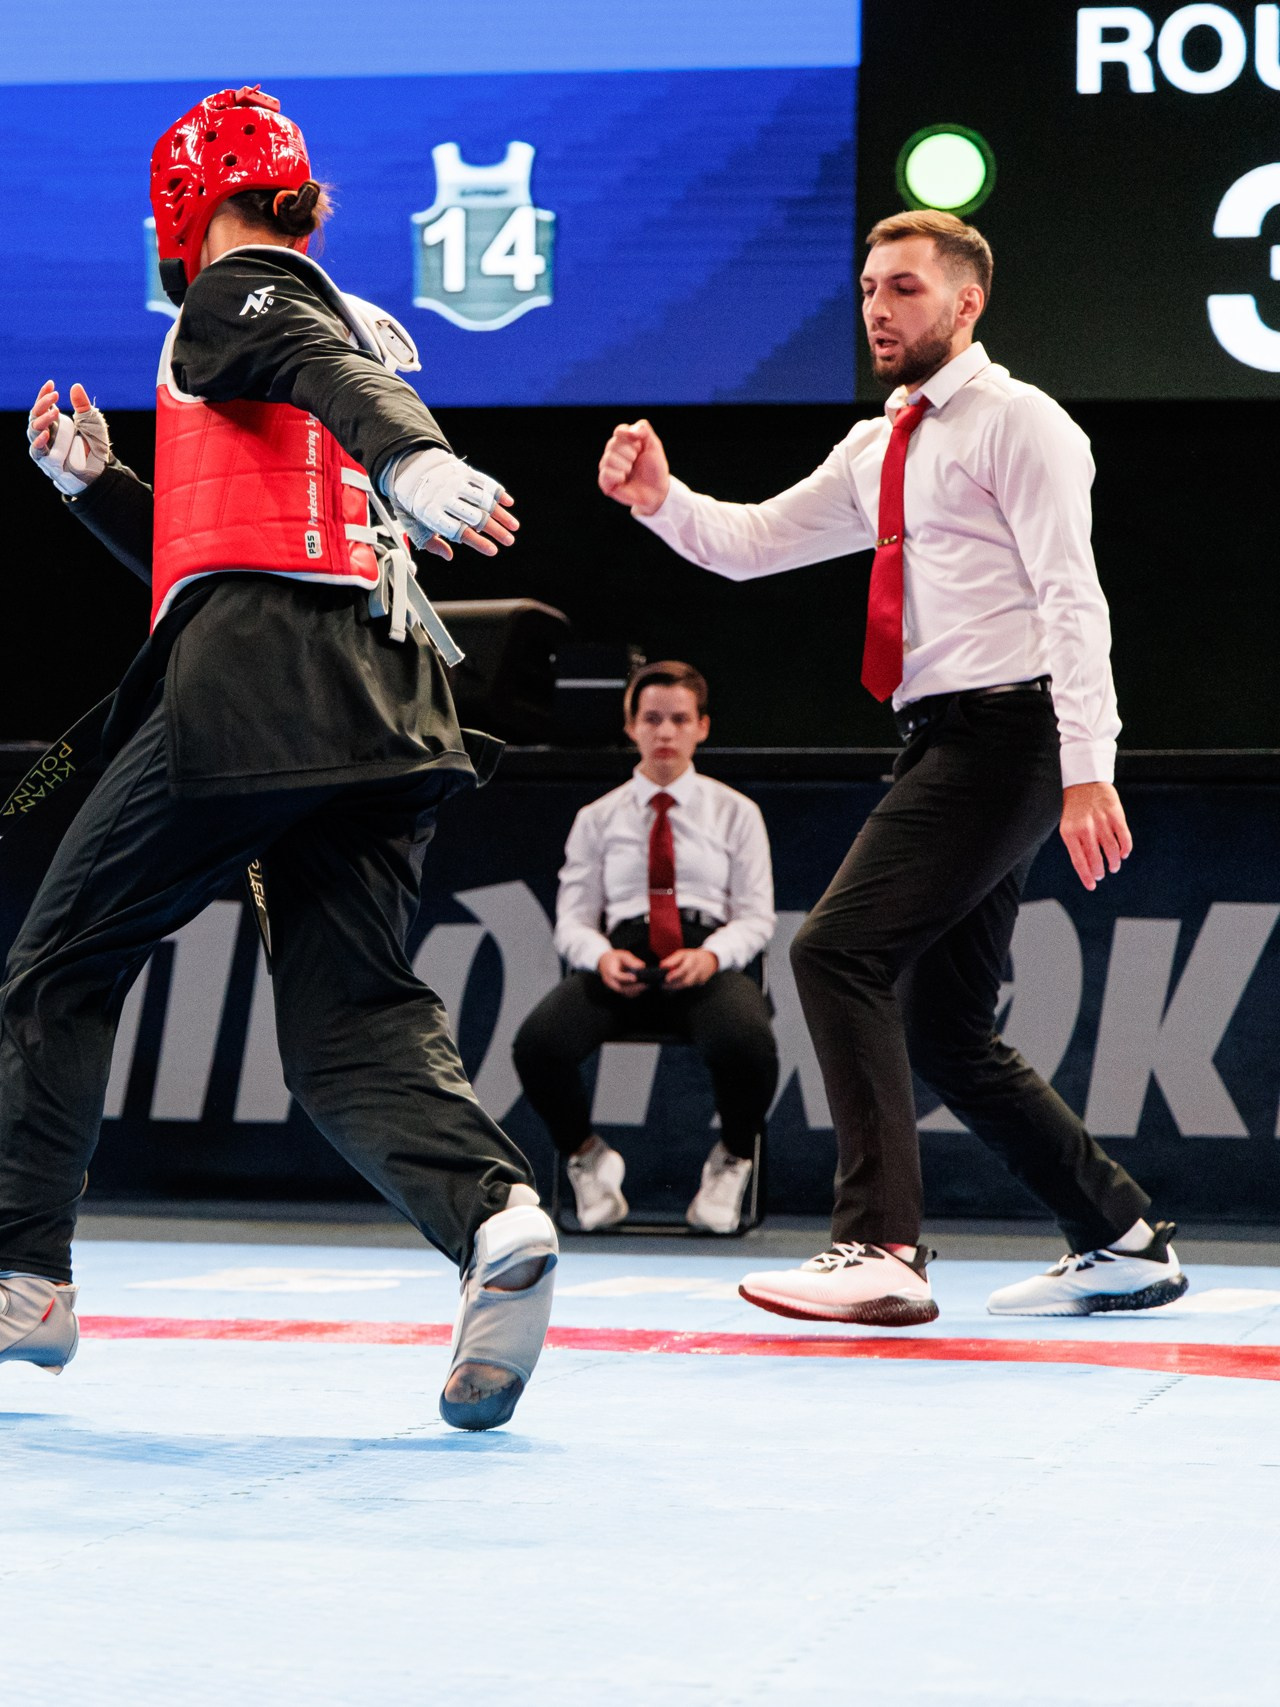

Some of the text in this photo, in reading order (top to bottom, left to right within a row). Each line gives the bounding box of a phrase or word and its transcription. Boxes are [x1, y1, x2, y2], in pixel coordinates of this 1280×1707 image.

[423, 206, 546, 292] 14
[306, 430, 320, 467] Scoring
[306, 479, 319, 527] Protector
[307, 535, 317, 555] PSS
[3, 741, 73, 816] POLINA
[20, 761, 76, 813] KHAN
